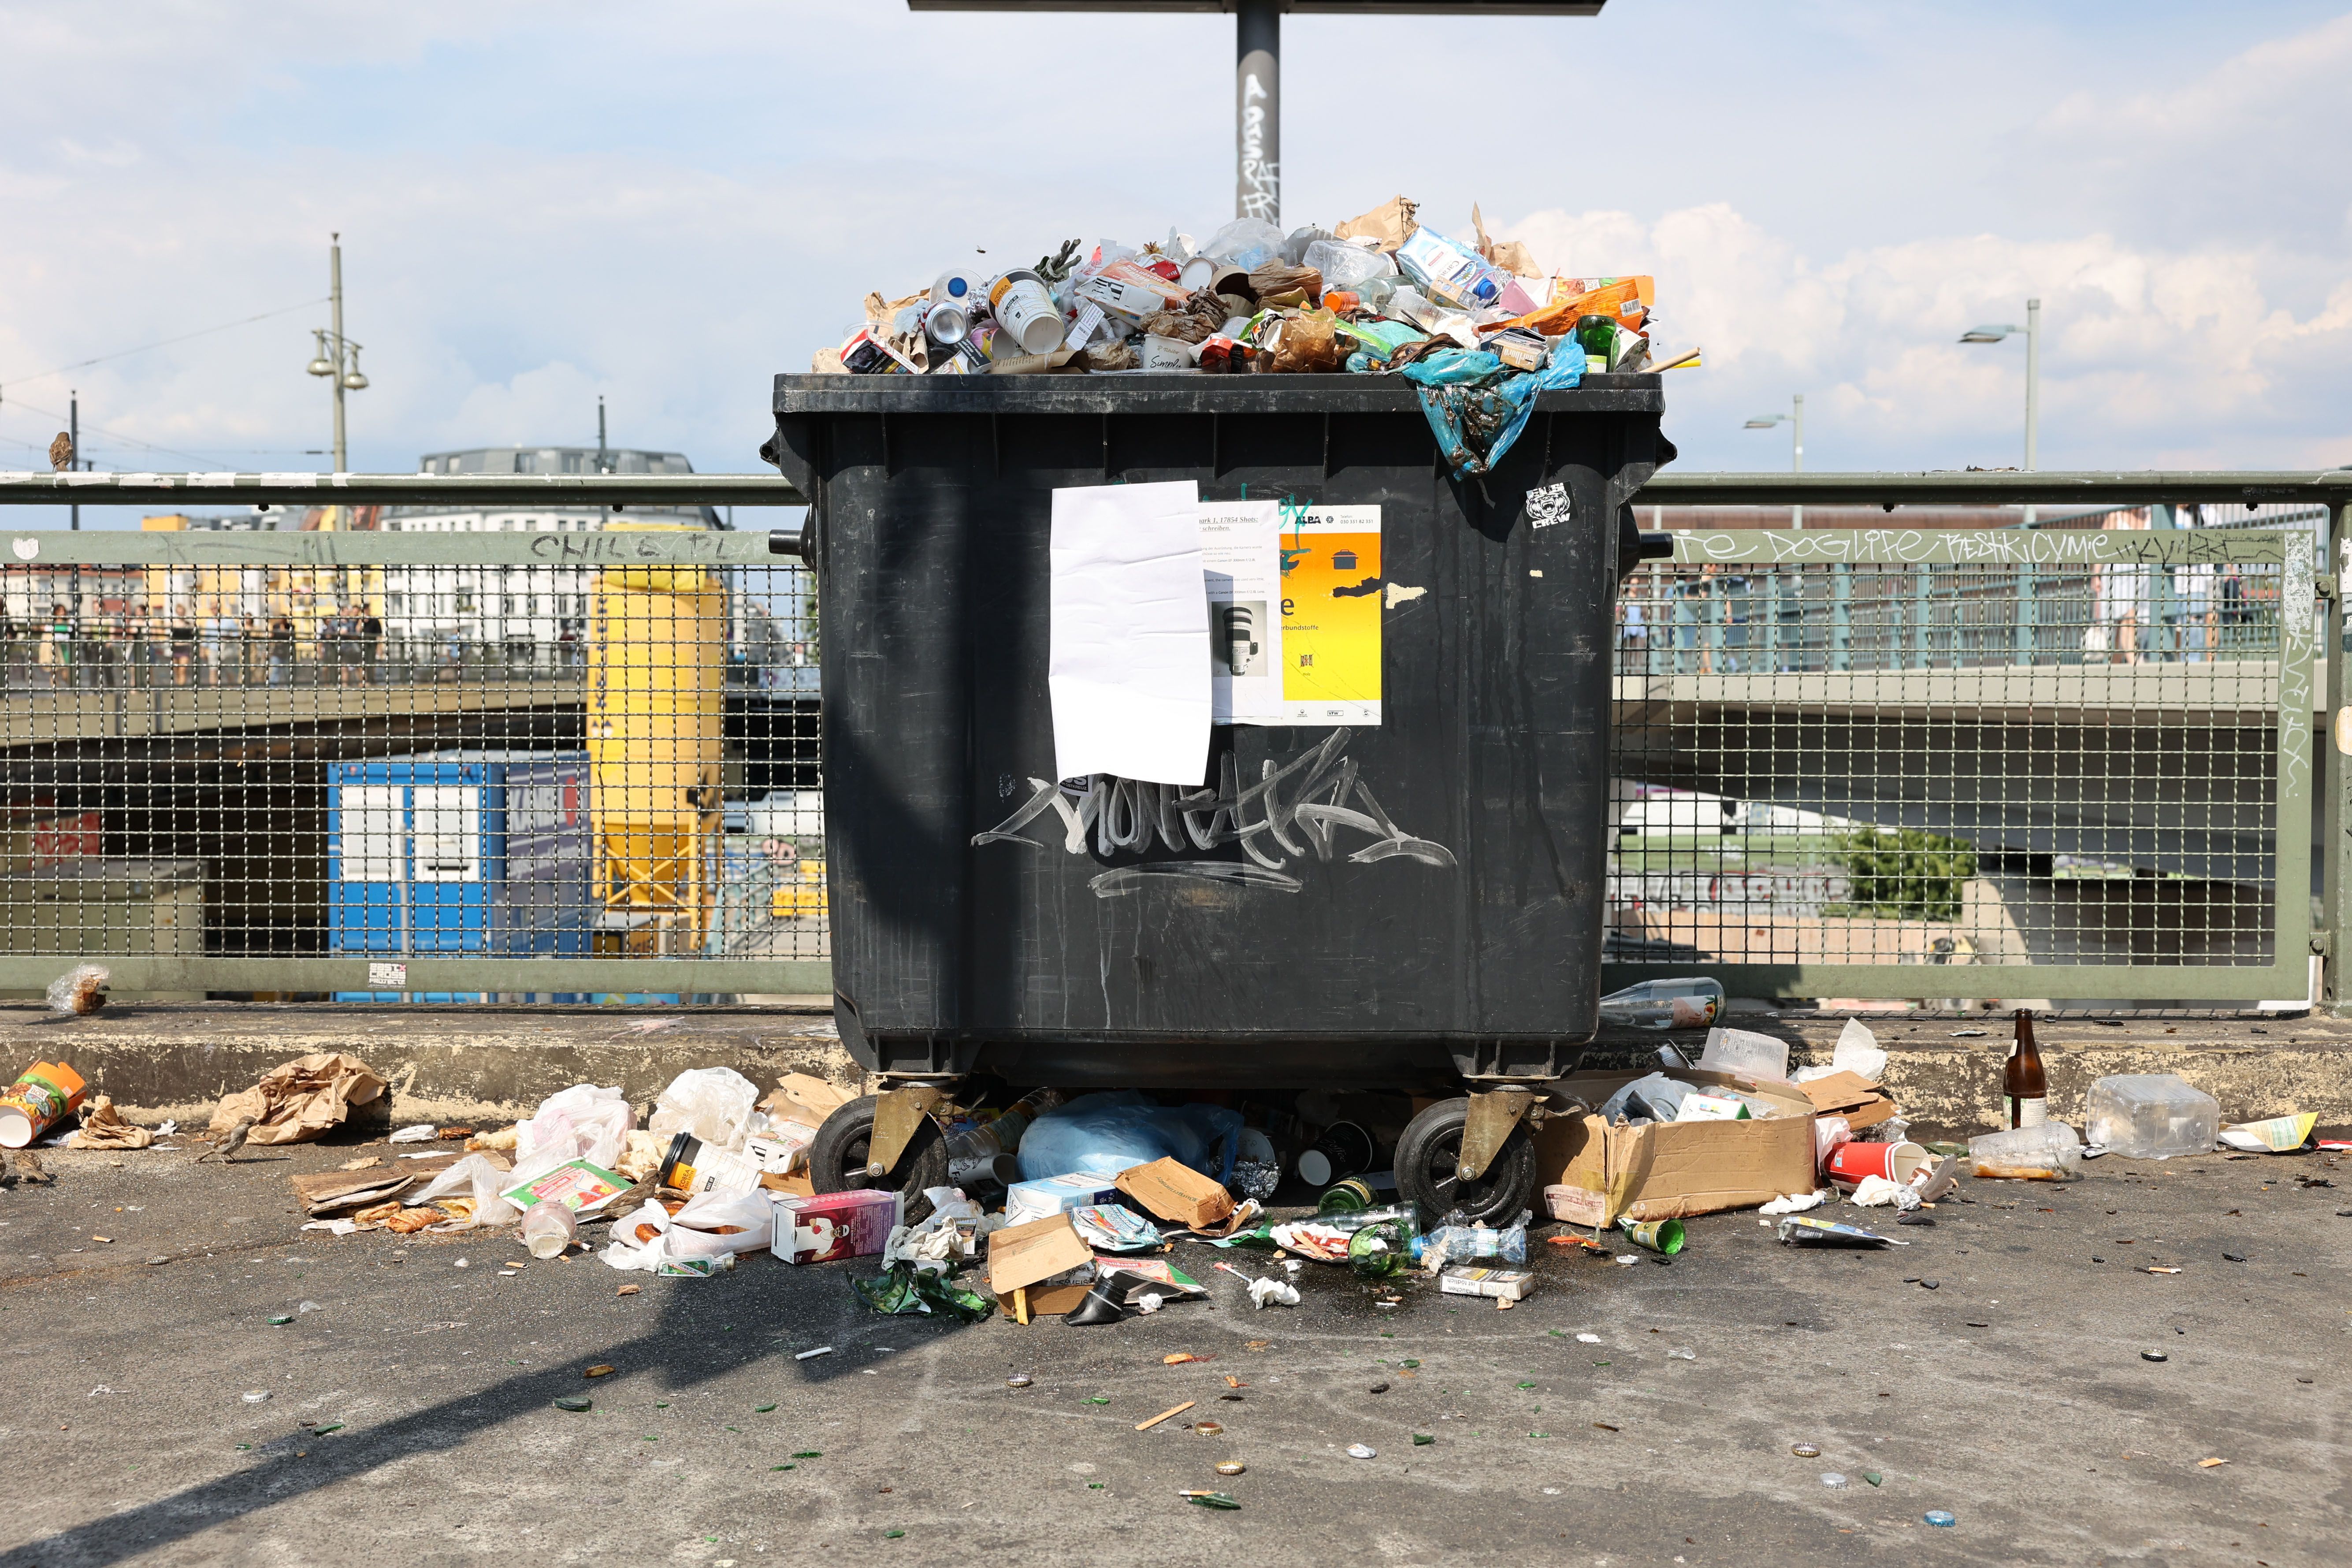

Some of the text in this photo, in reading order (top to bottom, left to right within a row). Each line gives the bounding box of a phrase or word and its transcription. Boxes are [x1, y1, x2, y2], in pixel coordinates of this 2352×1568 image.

[1532, 513, 1571, 529] CREW
[679, 1169, 690, 1187] COBEA
[1548, 1200, 1560, 1213] 834
[679, 1263, 699, 1274] KUEMMERLING
[1448, 1285, 1474, 1295] Rauchen
